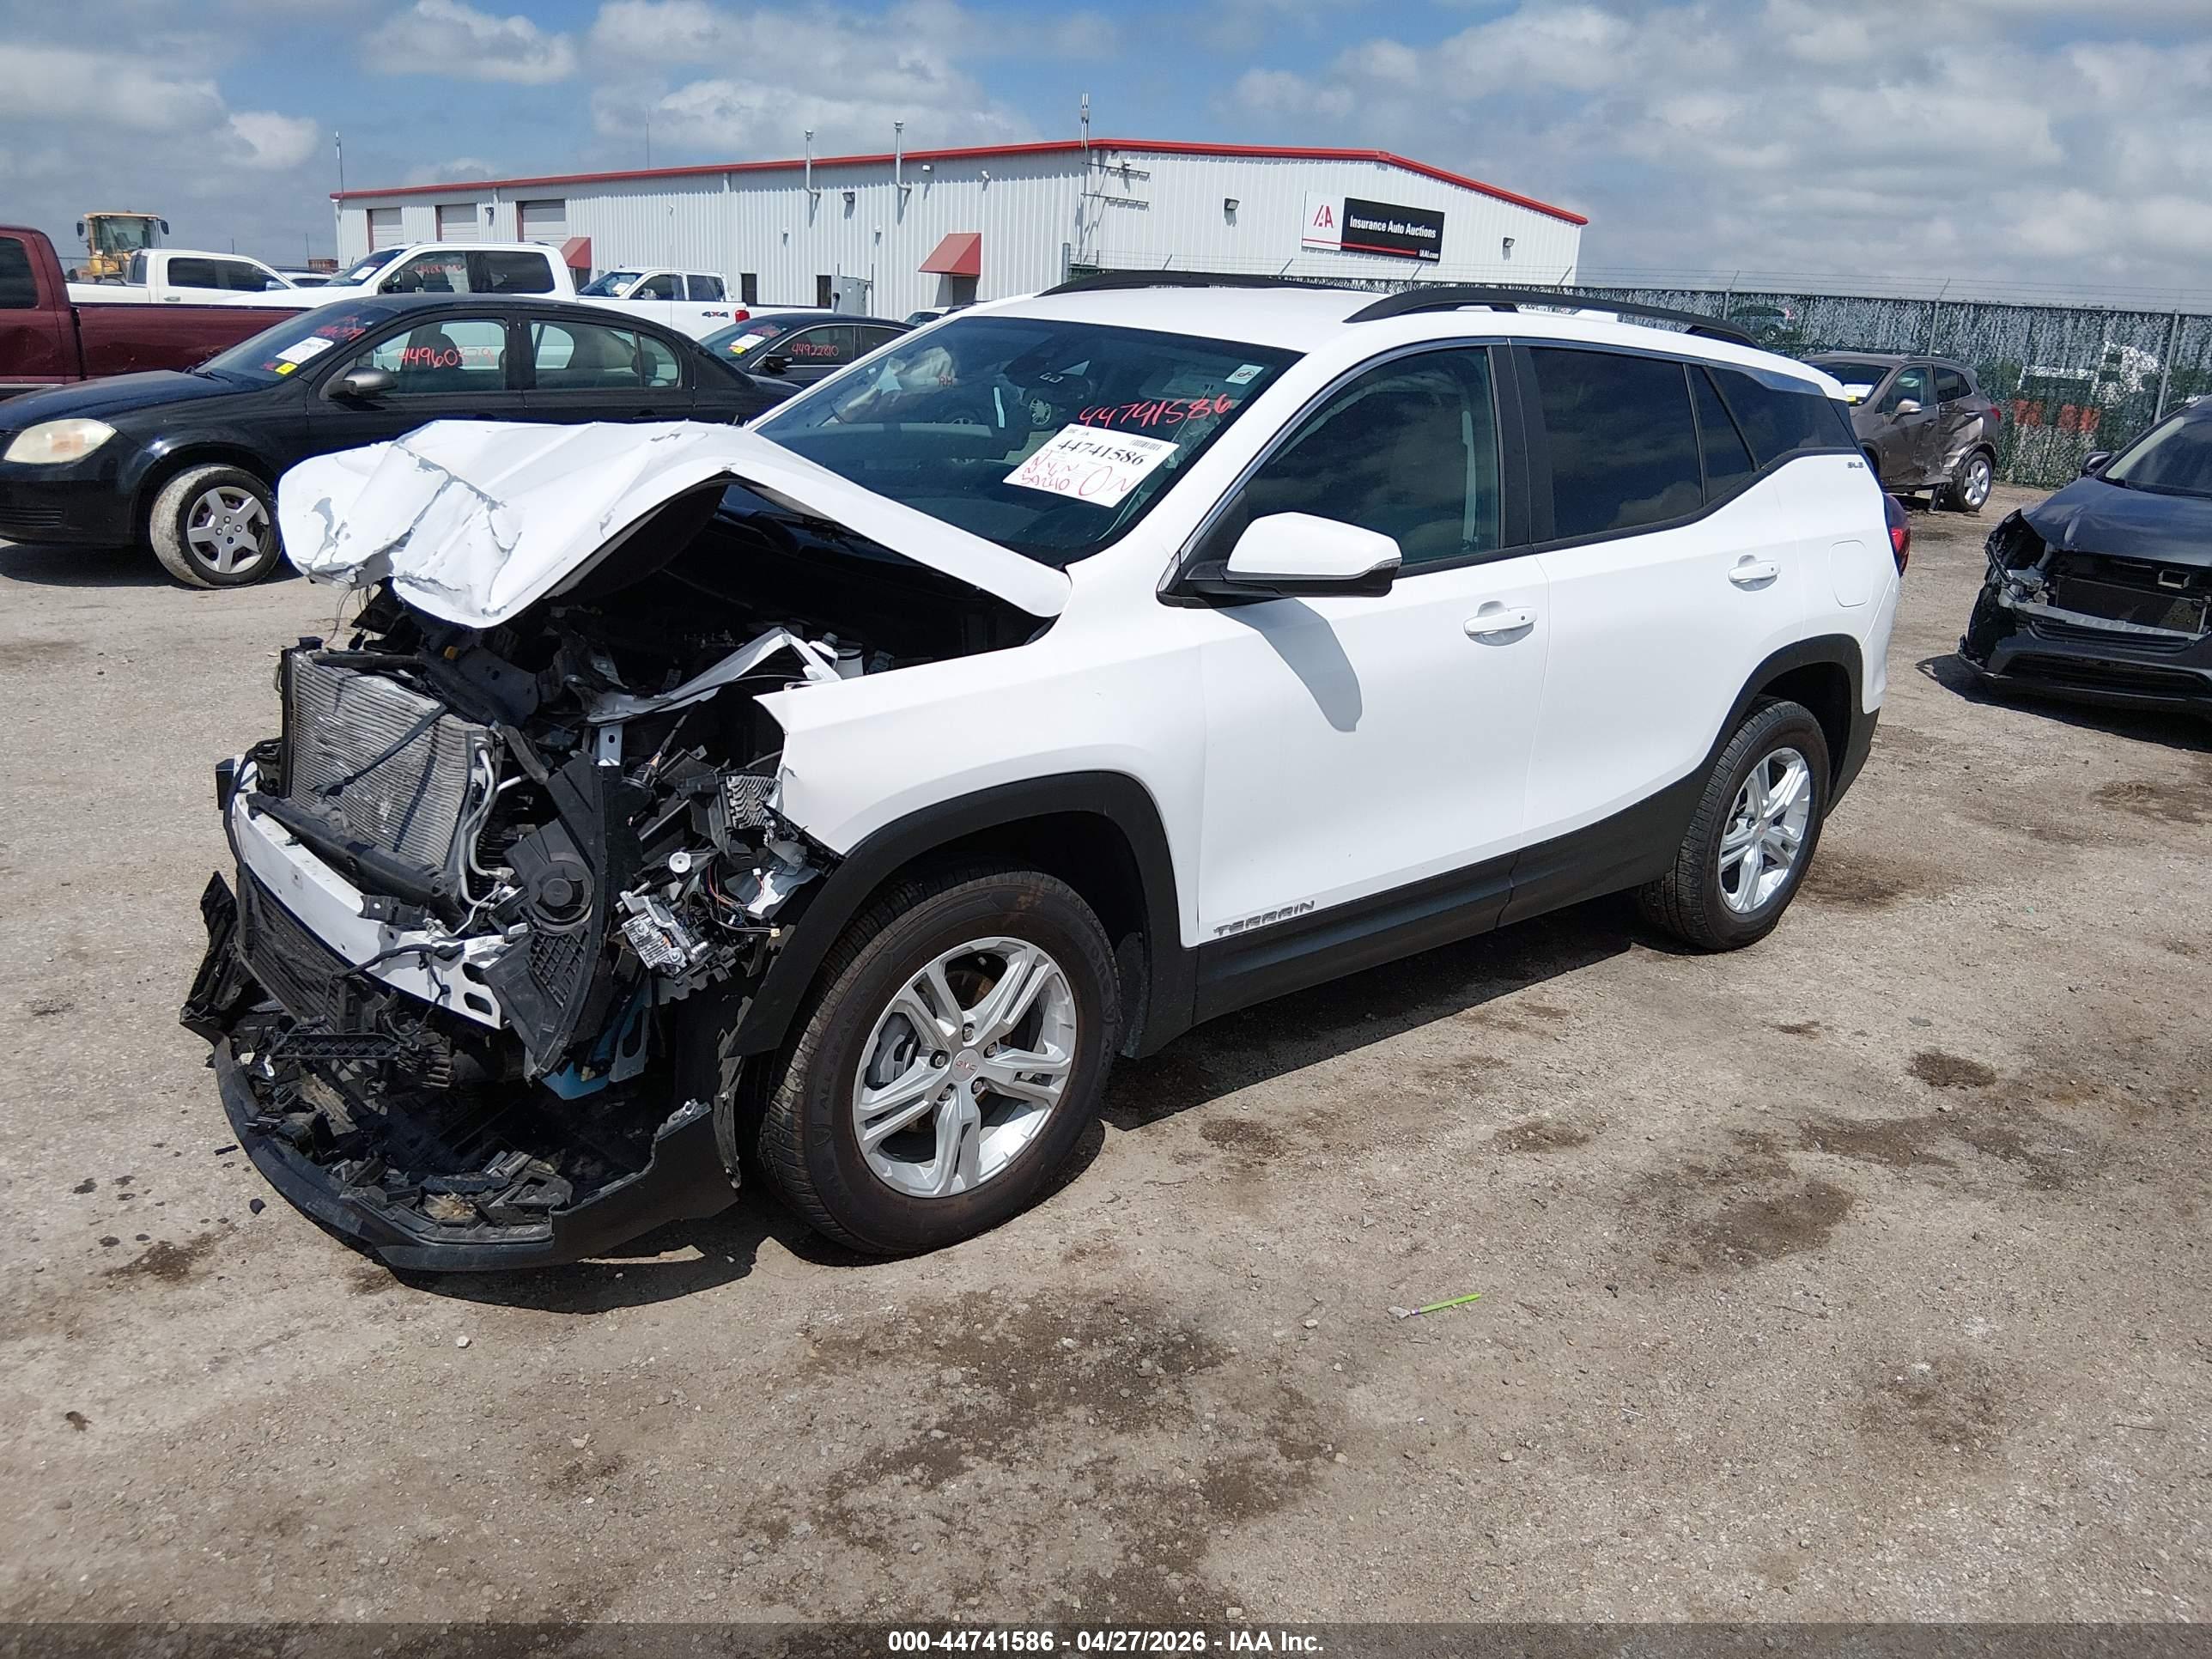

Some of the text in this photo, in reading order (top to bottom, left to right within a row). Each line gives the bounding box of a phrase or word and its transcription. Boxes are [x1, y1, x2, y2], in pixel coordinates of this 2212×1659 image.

[1350, 215, 1437, 239] Insurance Auto Auctions
[398, 346, 495, 368] 44960379
[791, 343, 839, 357] 44922810
[1079, 394, 1231, 427] 44741586
[1057, 439, 1149, 465] 44741586
[1213, 900, 1315, 936] TERRAIN
